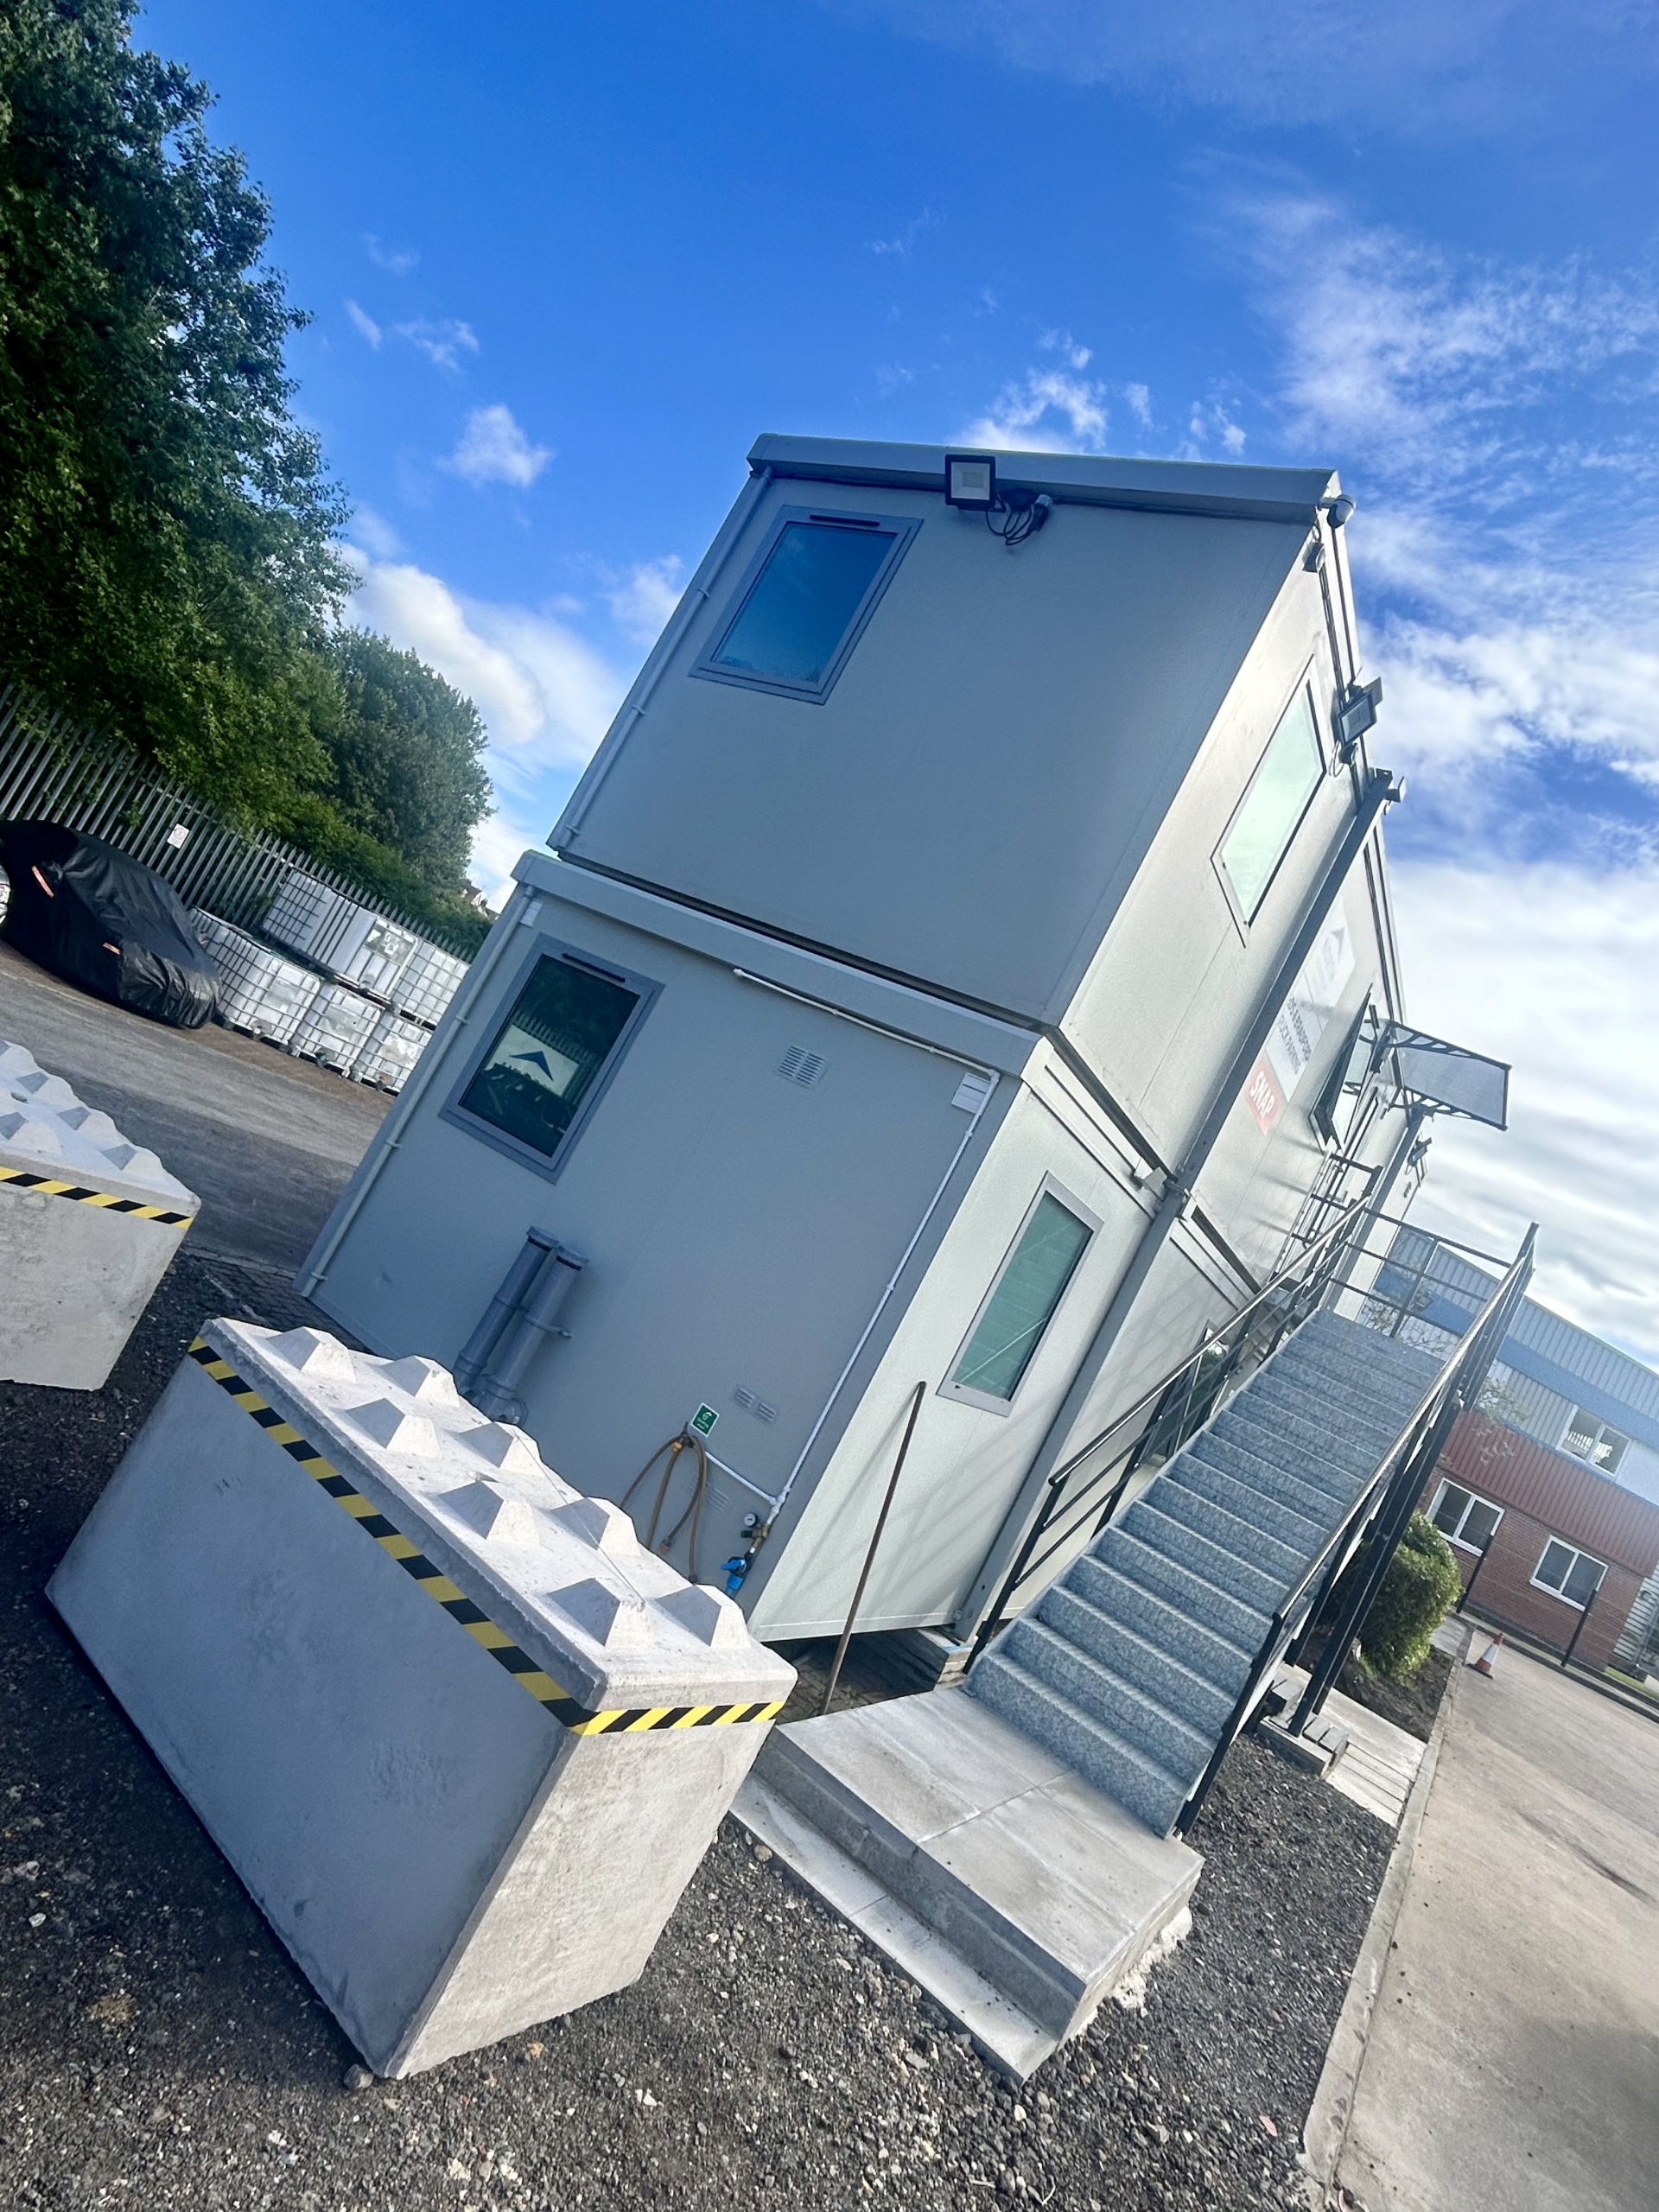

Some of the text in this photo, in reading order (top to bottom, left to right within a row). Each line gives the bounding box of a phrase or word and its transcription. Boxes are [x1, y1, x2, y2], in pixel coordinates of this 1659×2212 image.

[1278, 1014, 1301, 1075] RUCK PARKING
[1294, 1014, 1312, 1061] BRADFORD
[1249, 1071, 1274, 1119] SNAP
